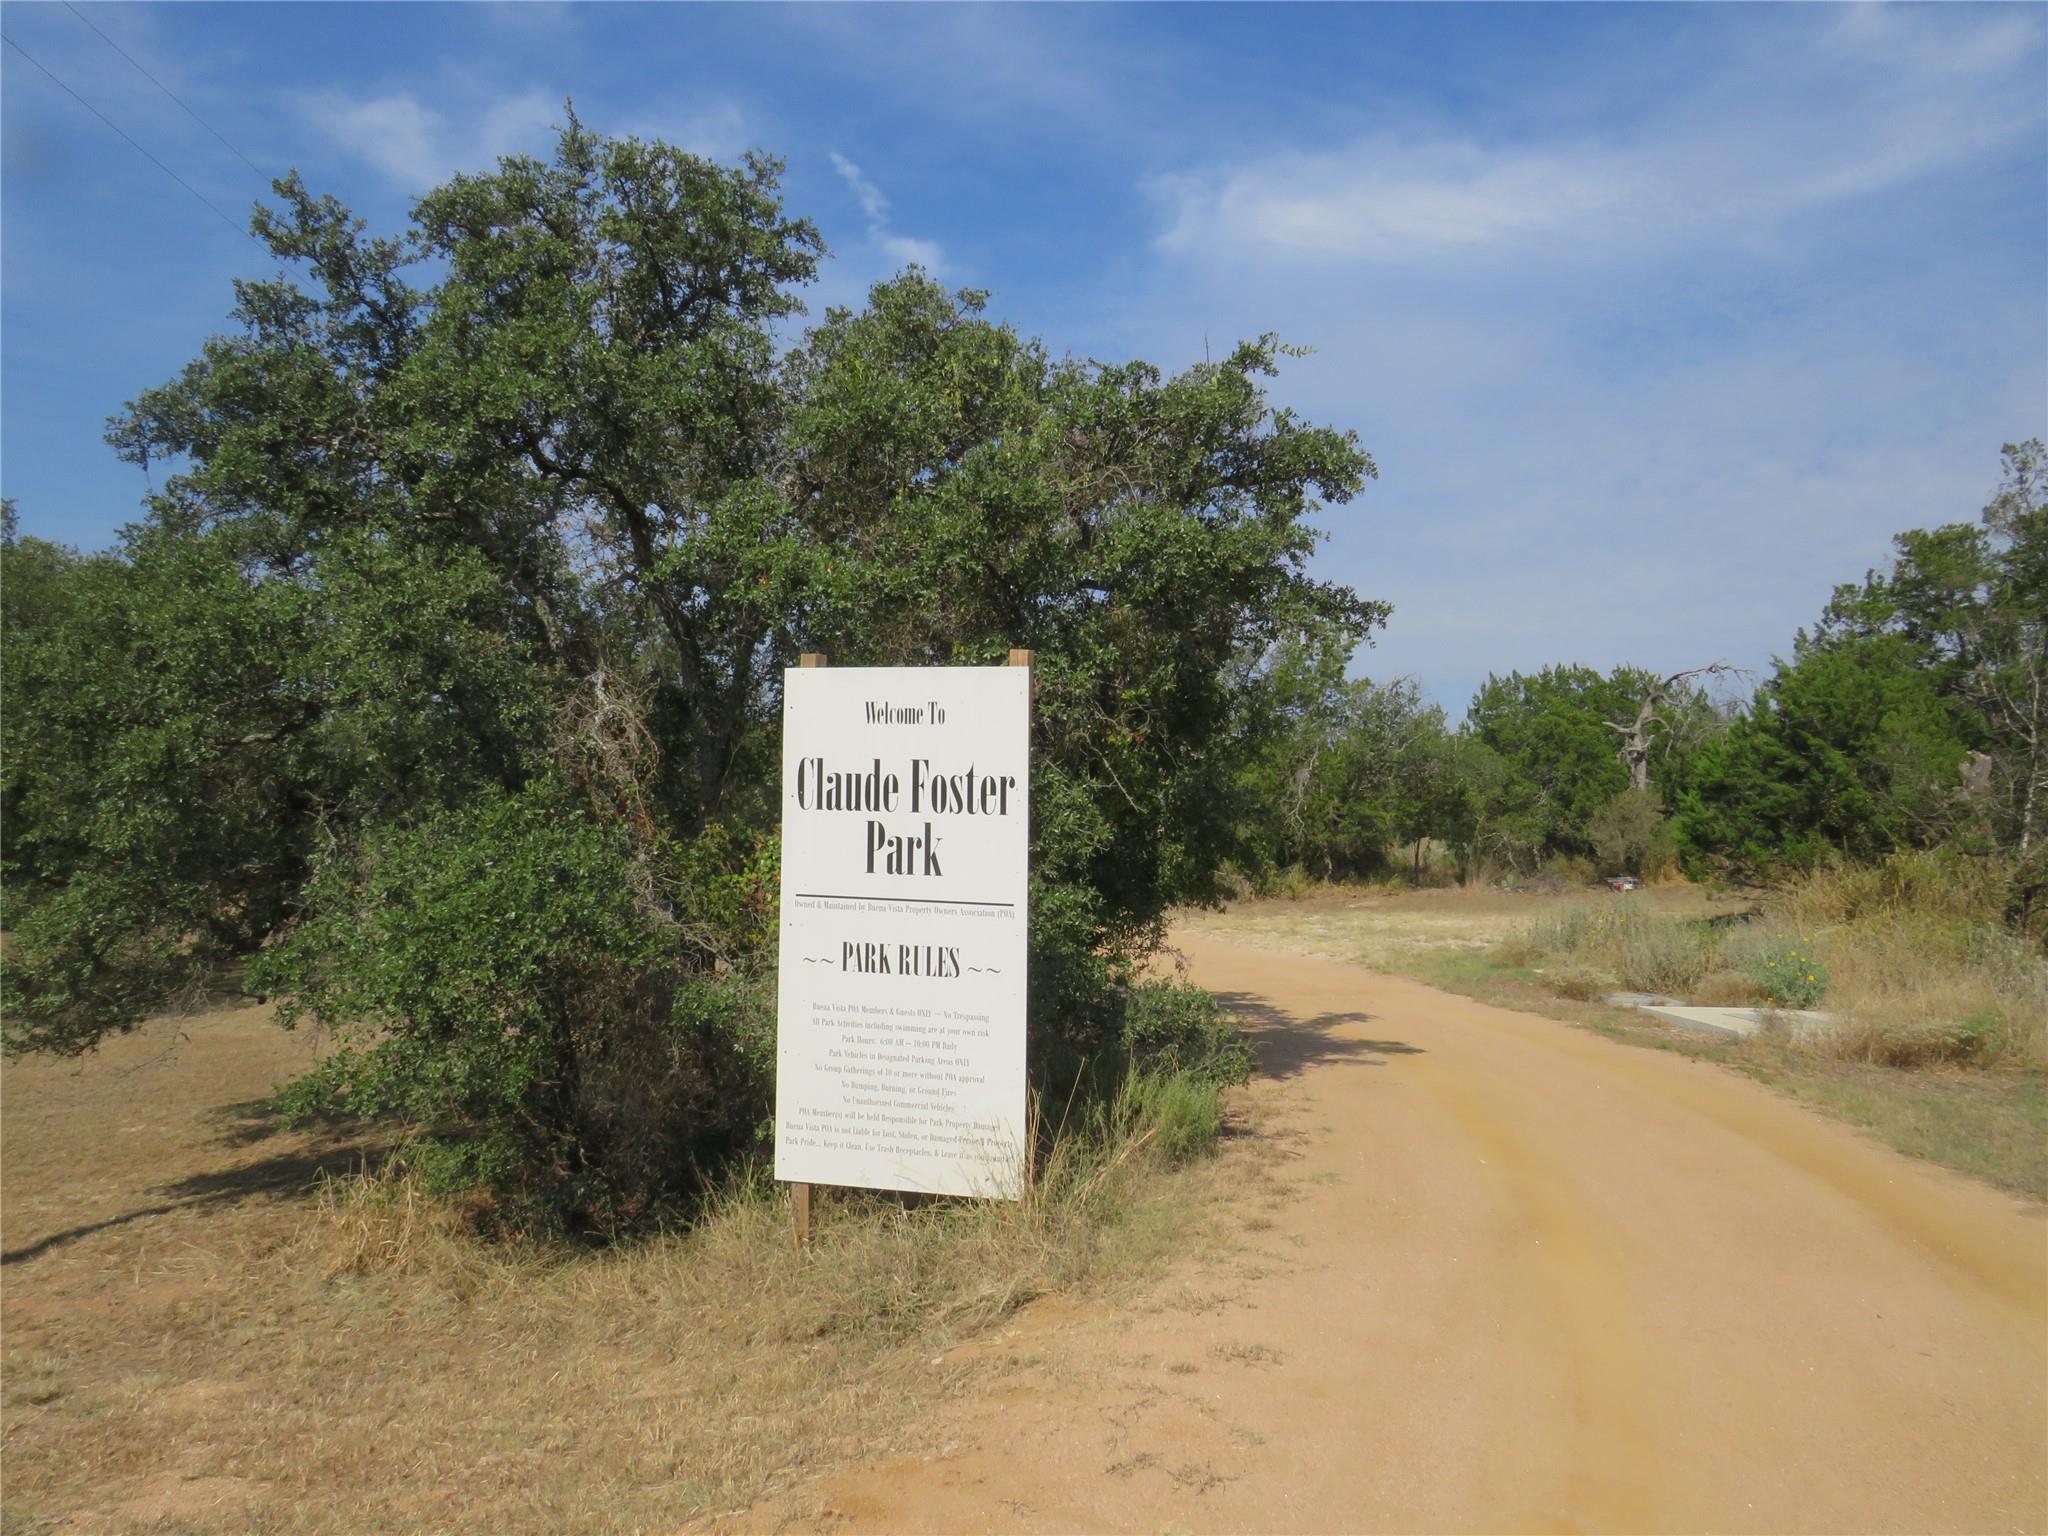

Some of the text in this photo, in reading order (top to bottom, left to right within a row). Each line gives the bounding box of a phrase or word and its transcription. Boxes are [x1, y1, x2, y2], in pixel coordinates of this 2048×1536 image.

[865, 701, 945, 725] Welcome To
[797, 756, 1016, 816] Claude Foster
[865, 820, 943, 876] Park
[794, 900, 814, 908] Owned
[824, 901, 856, 910] Maintained
[858, 902, 865, 912] by
[868, 903, 886, 912] Buena
[888, 904, 903, 912] Vista
[906, 905, 932, 916] Property
[934, 906, 957, 915] Owners
[842, 942, 960, 977] PARK RULES
